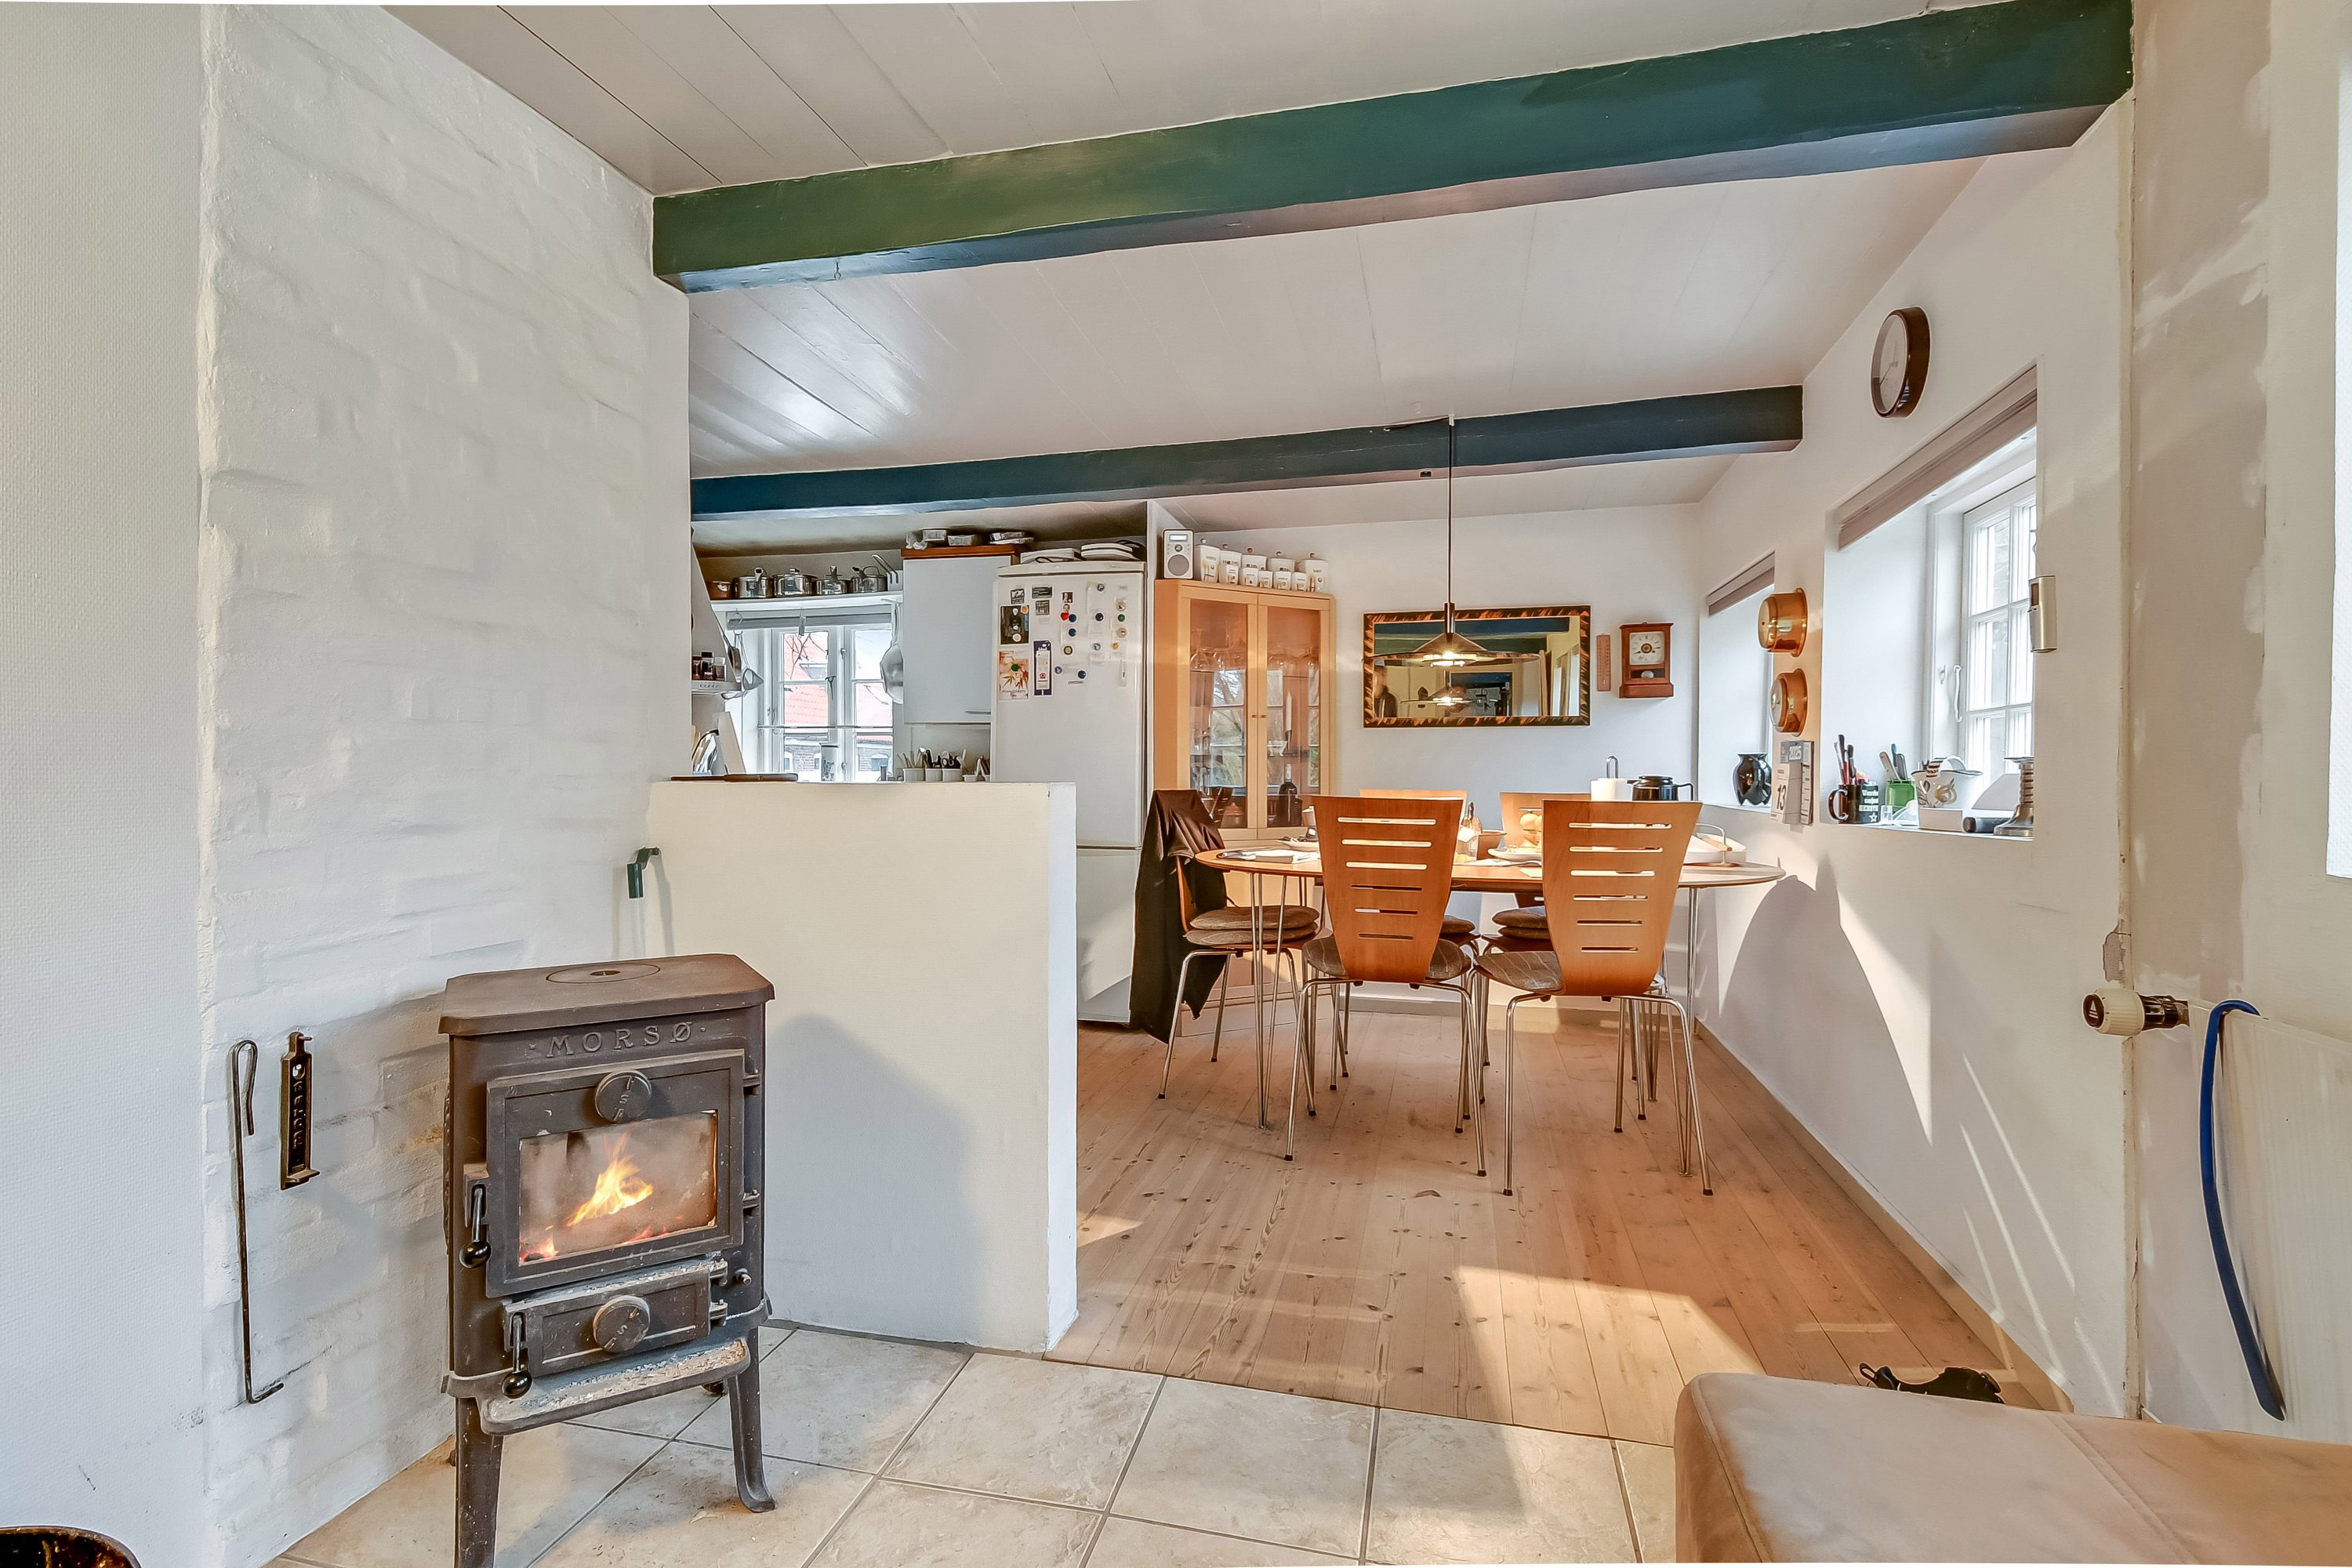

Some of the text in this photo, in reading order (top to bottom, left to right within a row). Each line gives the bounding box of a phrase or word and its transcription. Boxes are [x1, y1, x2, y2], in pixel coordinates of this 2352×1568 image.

[1789, 746, 1802, 760] 2025
[1777, 784, 1787, 811] 13
[546, 1022, 692, 1058] MORSØ
